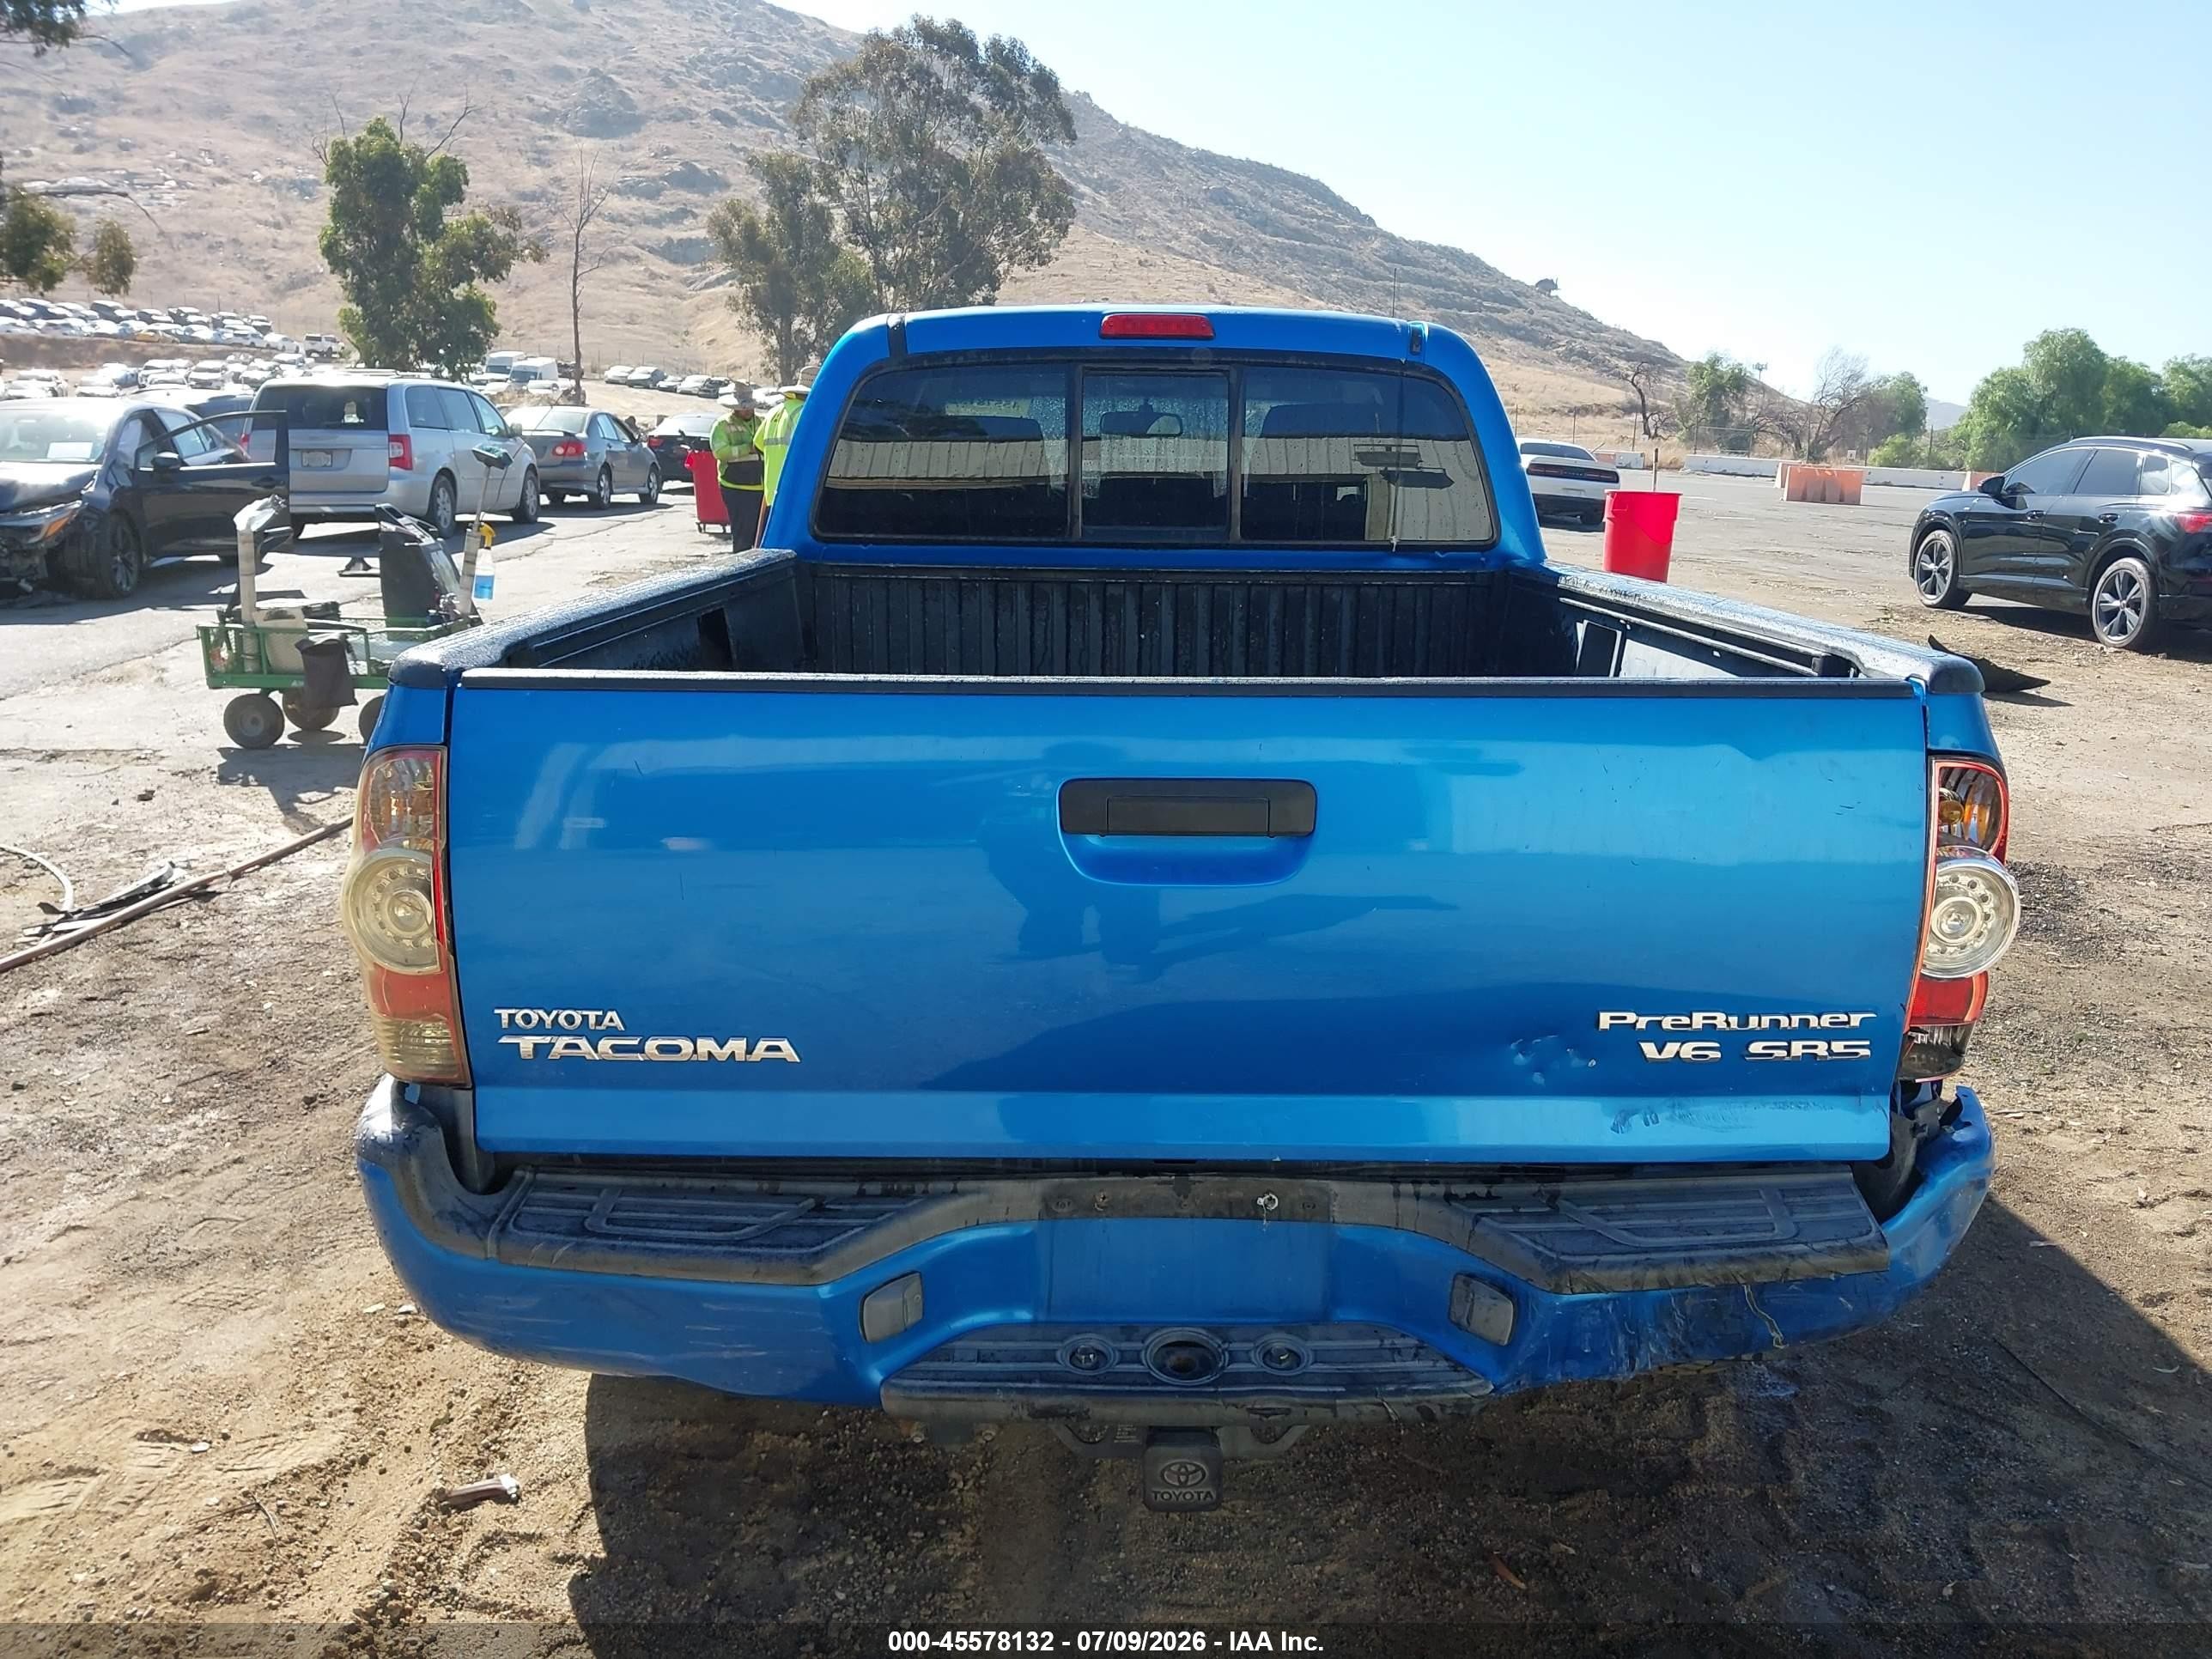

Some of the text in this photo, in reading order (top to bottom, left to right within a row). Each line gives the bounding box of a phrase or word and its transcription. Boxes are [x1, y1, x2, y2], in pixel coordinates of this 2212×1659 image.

[494, 1007, 625, 1031] TOYOTA
[1597, 1010, 1878, 1031] PreRunner
[496, 1035, 802, 1063] TACOMA
[1638, 1039, 1872, 1063] V6 SR5
[1152, 1489, 1215, 1503] TOYOTA
